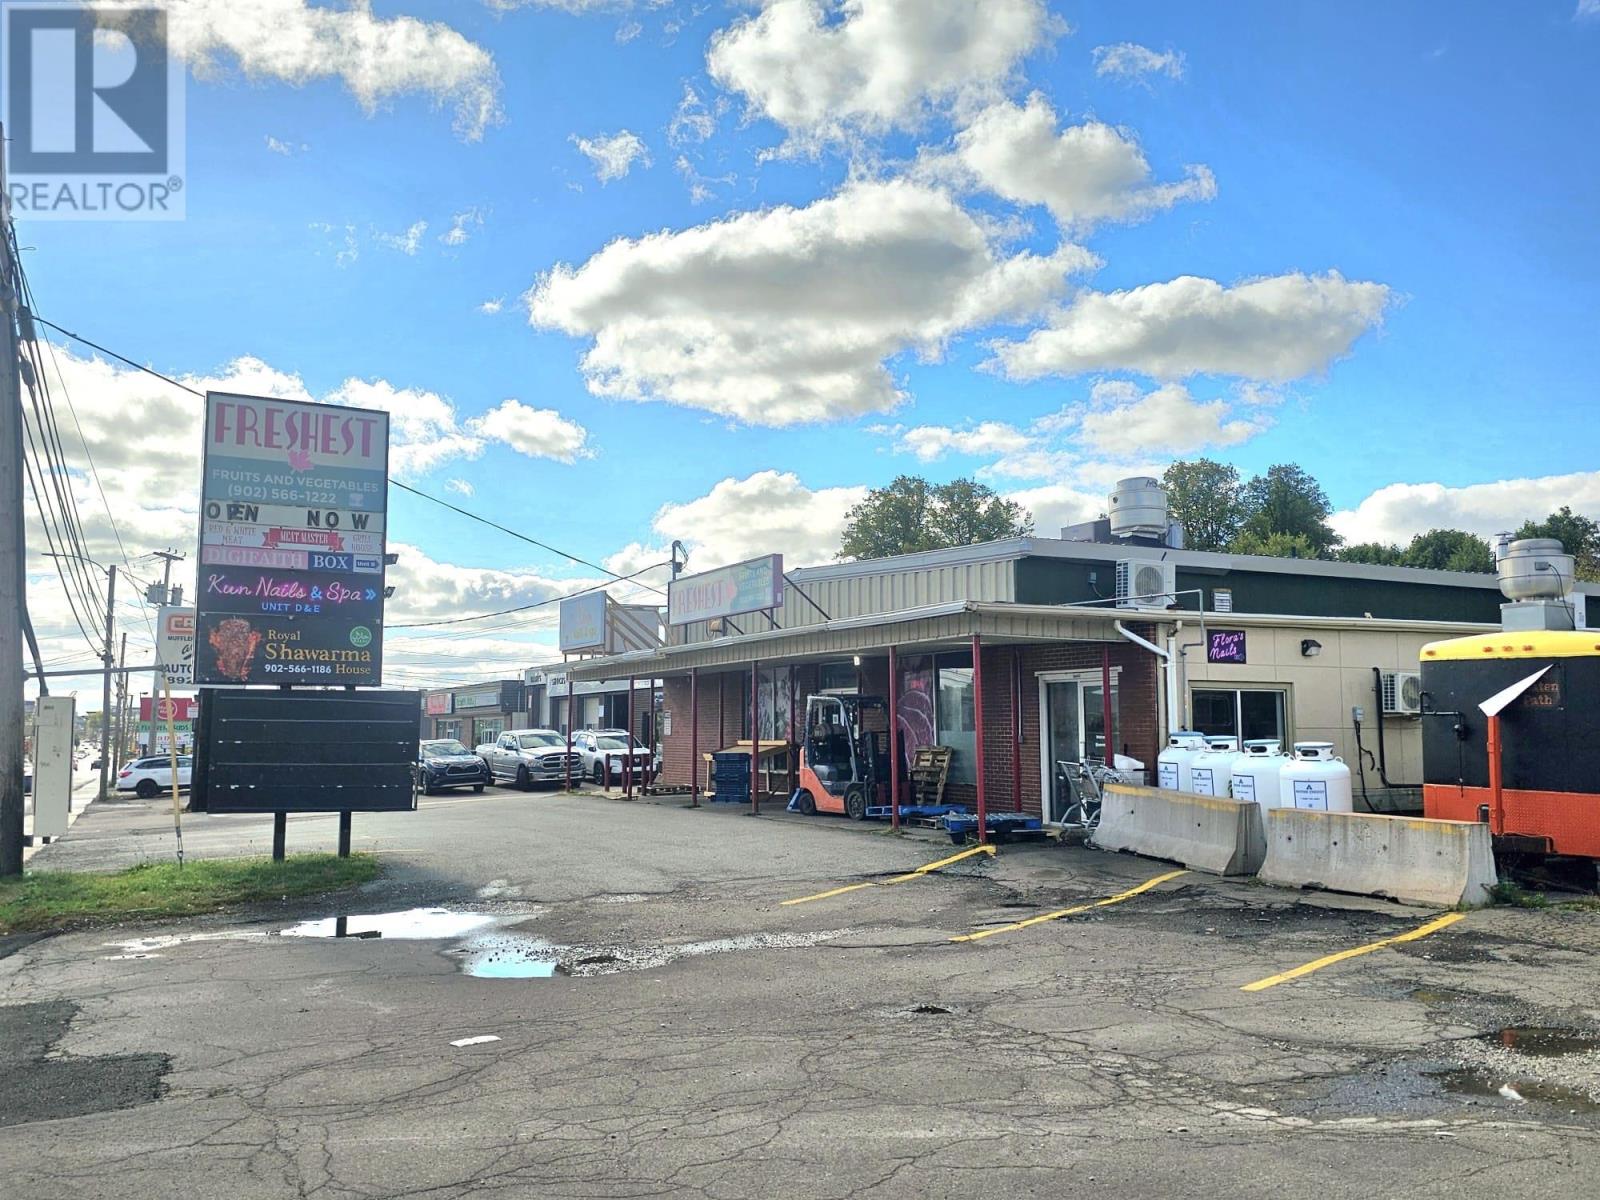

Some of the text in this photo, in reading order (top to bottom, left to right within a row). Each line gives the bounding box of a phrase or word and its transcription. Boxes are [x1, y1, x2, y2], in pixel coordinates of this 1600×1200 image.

[214, 402, 378, 457] FRESHEST
[212, 469, 378, 493] FRUITS AND VEGETABLES
[227, 484, 337, 504] (902) 566-1222
[222, 535, 244, 545] MEAT
[280, 531, 329, 545] MEAT MASTER
[208, 549, 349, 570] DIGIFAITH BOX
[255, 576, 307, 599] Nails
[310, 585, 322, 600] &
[326, 582, 361, 604] Spa
[262, 602, 290, 612] UNIT
[268, 629, 301, 643] Royal
[1212, 632, 1244, 647] Flora's
[264, 643, 372, 662] Shawarma
[1209, 643, 1237, 660] Nails
[264, 664, 371, 675] 902-566-1186 House
